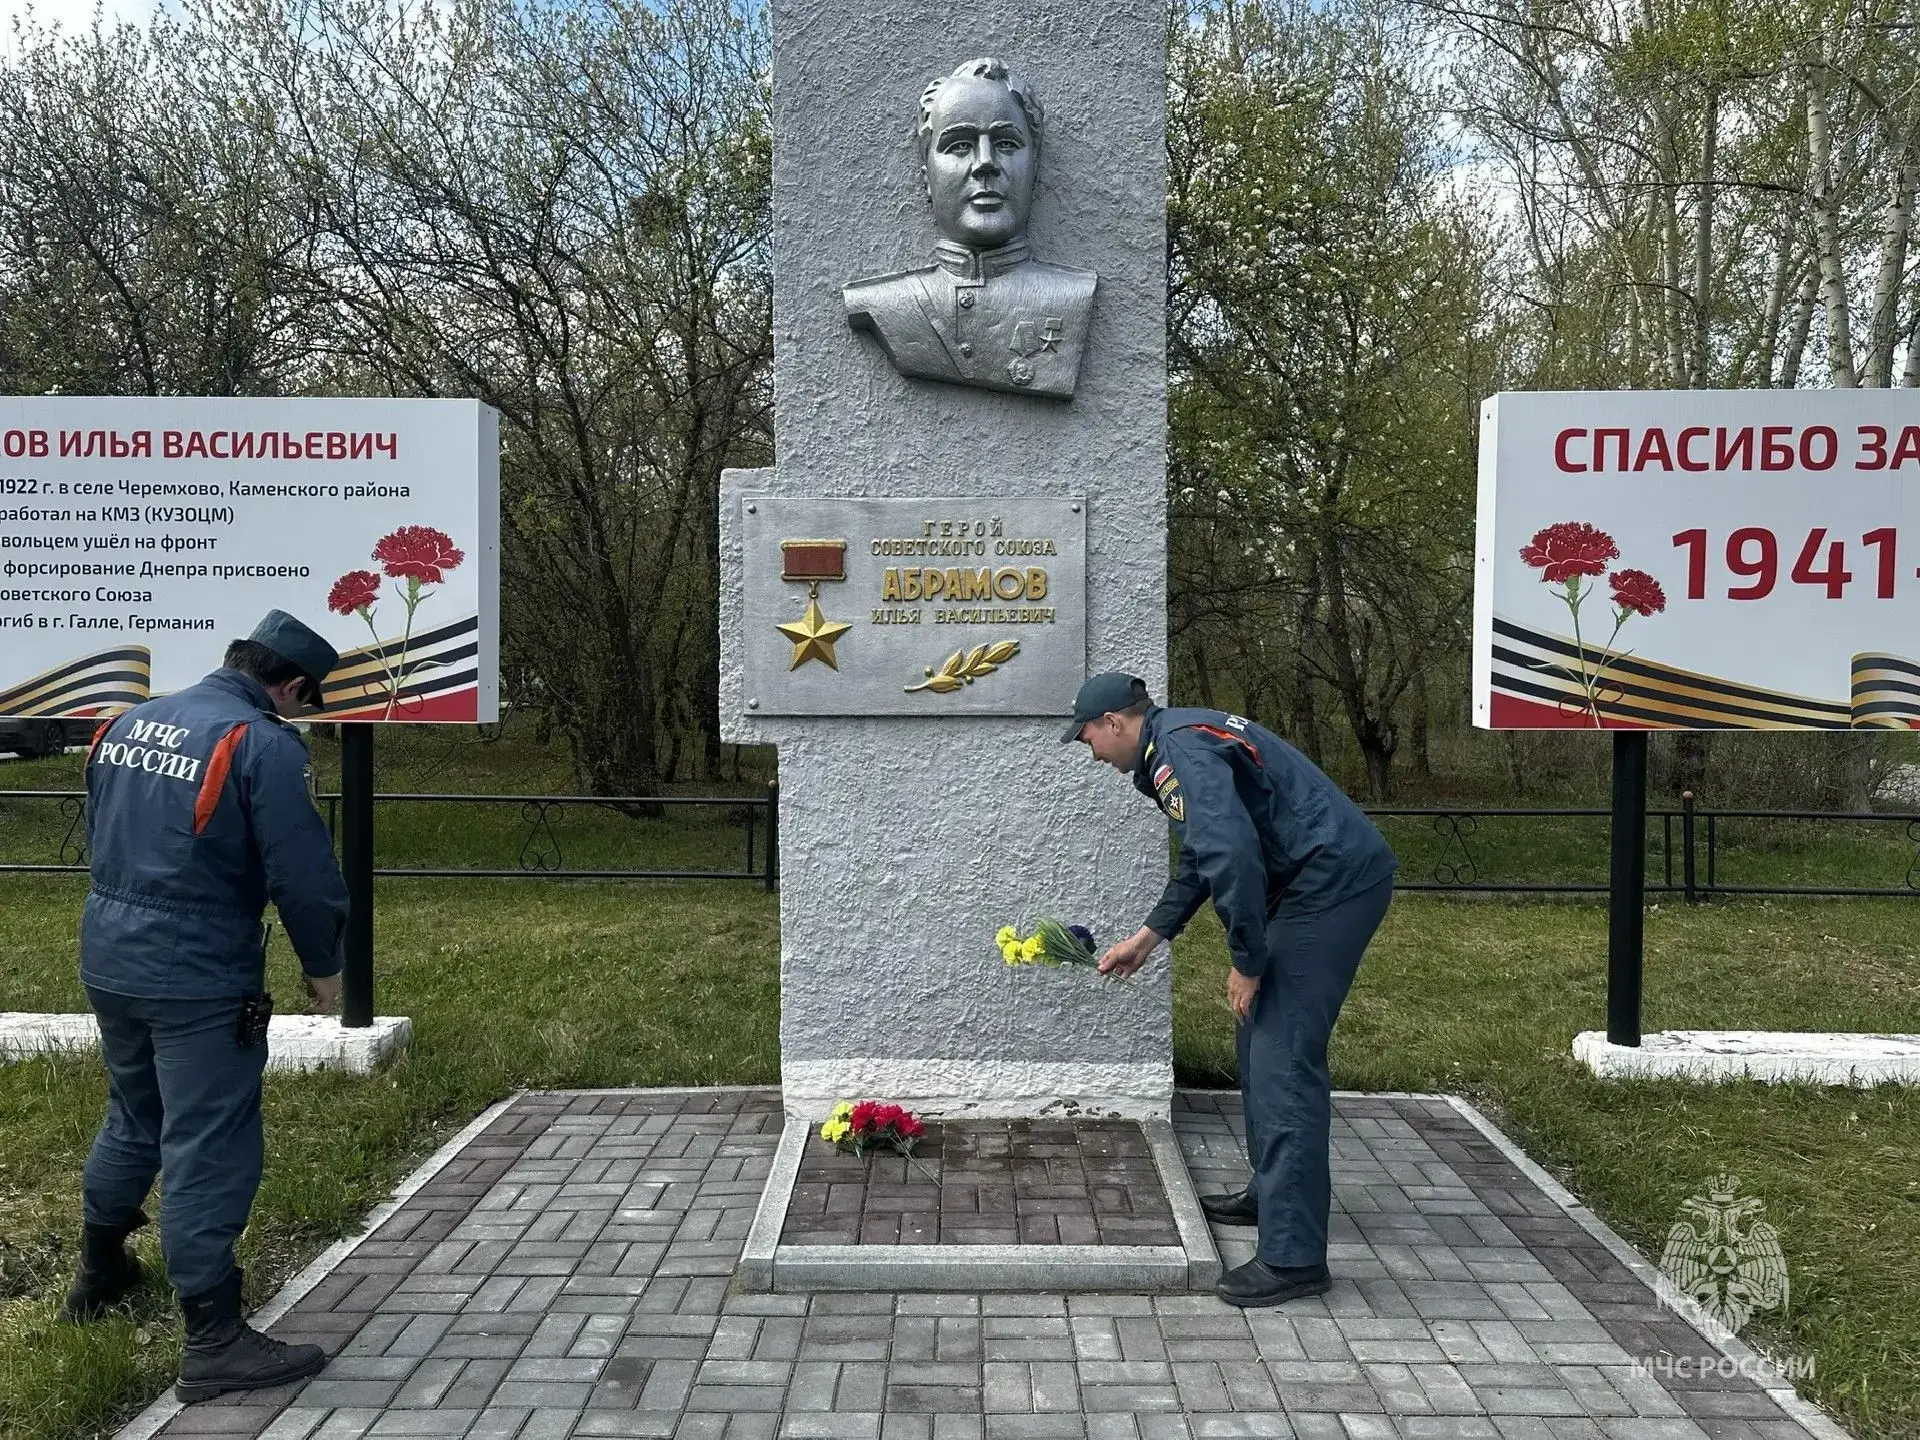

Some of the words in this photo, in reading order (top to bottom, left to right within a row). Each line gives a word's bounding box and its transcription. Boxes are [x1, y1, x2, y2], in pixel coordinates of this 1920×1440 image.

[0, 429, 49, 458] ОВ
[59, 430, 152, 458] ИЛЬЯ
[163, 430, 397, 460] ВАСИЛЬЕВИЧ
[1554, 425, 1838, 473] СПАСИБО
[1855, 425, 1920, 471] ЗА
[0, 478, 38, 495] 1922
[42, 482, 54, 495] г.
[58, 482, 69, 495] в
[73, 482, 114, 495] селе
[118, 479, 224, 499] Черемхово,
[229, 480, 339, 497] Каменского
[343, 482, 410, 501] района
[0, 505, 71, 525] работал
[75, 510, 97, 522] на
[101, 506, 140, 522] КМЗ
[144, 505, 235, 526] (КУЗОЦМ)
[923, 515, 1003, 538] ГЕРОЙ
[1, 536, 79, 551] вольцем
[82, 533, 130, 553] ушёл
[134, 537, 156, 549] на
[160, 533, 218, 553] фронт
[870, 538, 985, 557] СОВЕТСКОГО
[994, 538, 1057, 557] СОЮЗА
[3, 559, 136, 579] форсирование
[139, 560, 208, 580] Днепра
[212, 563, 310, 580] присвоено
[1671, 527, 1920, 600] 1941
[0, 589, 91, 602] оветского
[95, 586, 152, 603] Союза
[882, 566, 1048, 601] АБРАМОВ
[38, 617, 48, 629] в
[53, 617, 65, 629] г.
[69, 613, 124, 632] Галле,
[128, 614, 215, 633] Германия
[871, 607, 921, 624] ИЛЬЯ
[935, 607, 1056, 624] ВАСИЛЬЕВИЧ
[125, 719, 189, 748] МЧС
[98, 742, 200, 782] РОССИИ
